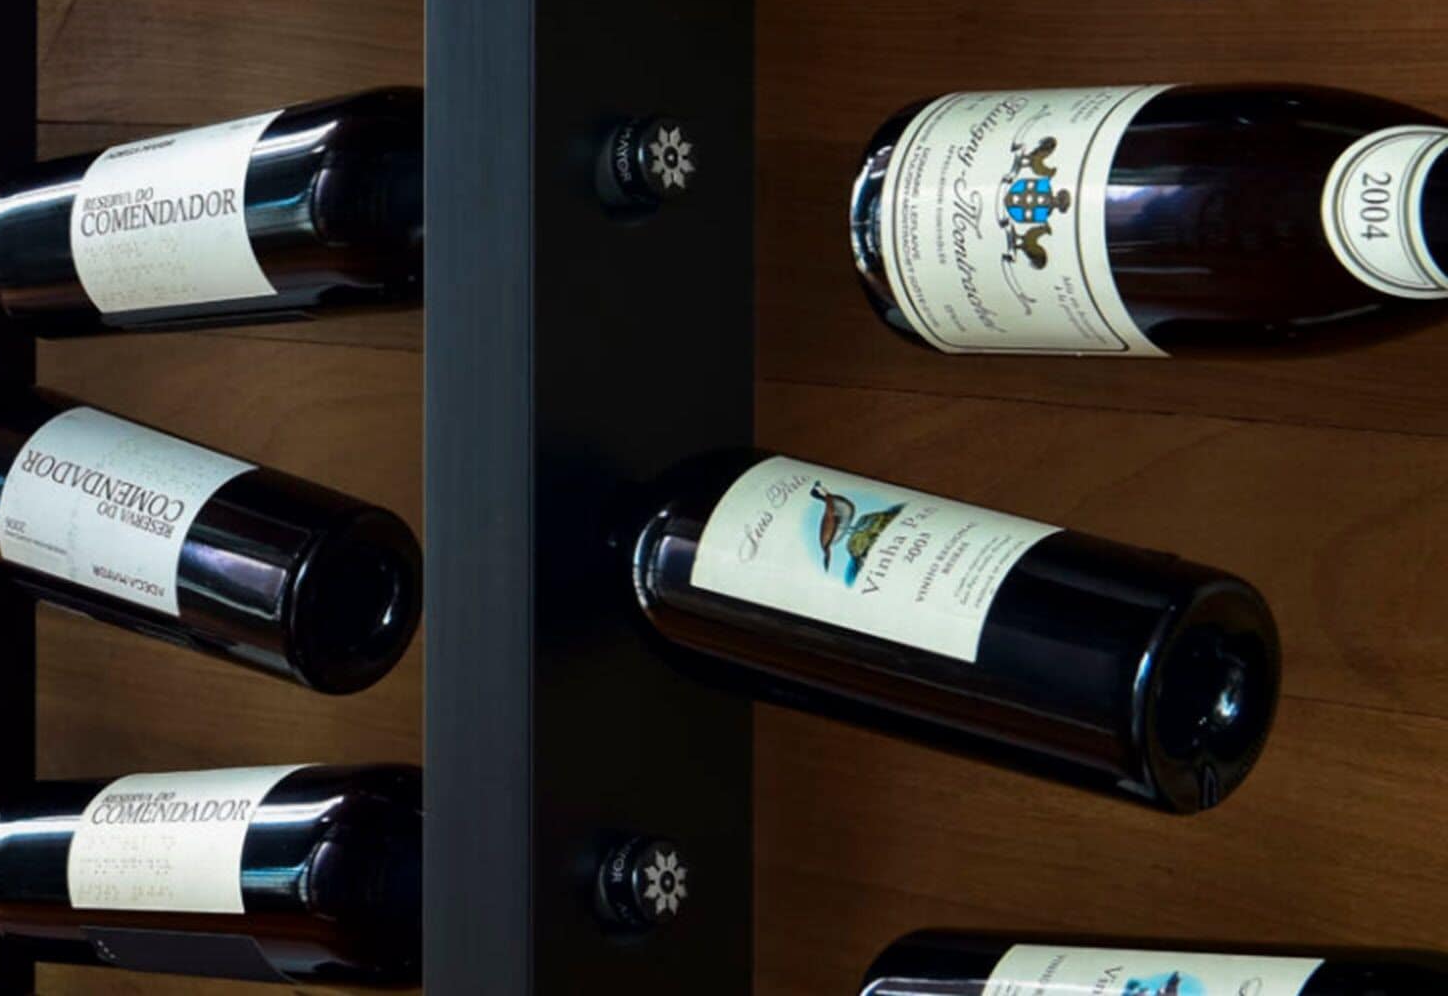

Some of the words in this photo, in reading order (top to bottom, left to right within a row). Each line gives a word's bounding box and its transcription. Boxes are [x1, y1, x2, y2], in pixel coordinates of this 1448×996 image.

[911, 148, 931, 197] DOMAINE
[78, 187, 238, 237] COMENDADOR
[83, 192, 133, 212] RESERVA
[135, 186, 154, 203] DO
[1360, 170, 1391, 240] 2004
[910, 205, 922, 260] LEFLAIVE
[19, 449, 184, 520] COMENDADOR
[96, 503, 118, 520] DO
[119, 508, 174, 538] RESERVA
[860, 531, 908, 595] Vinha
[914, 562, 939, 602] VINHO
[92, 800, 256, 825] COMENDADOR
